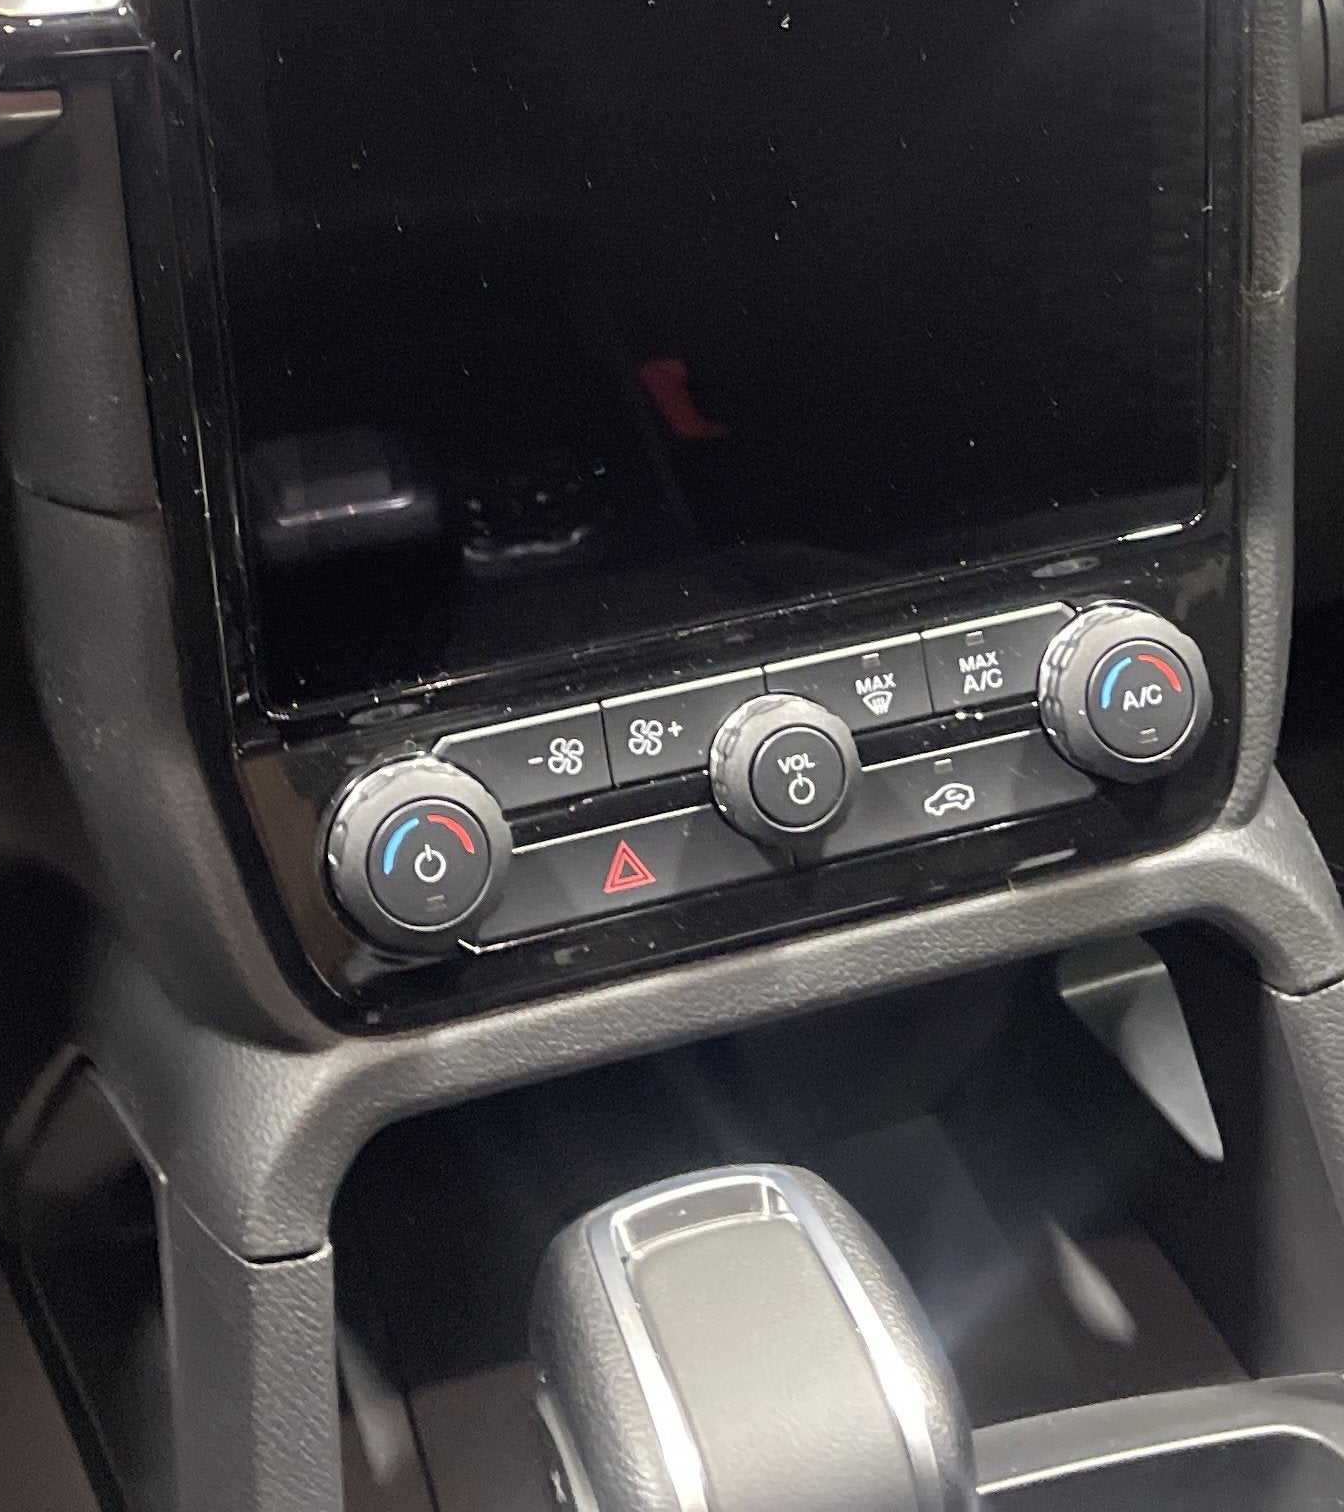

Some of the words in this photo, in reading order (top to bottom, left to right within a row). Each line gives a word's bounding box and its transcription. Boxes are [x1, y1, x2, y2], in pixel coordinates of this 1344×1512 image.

[959, 651, 999, 673] MAX
[854, 672, 897, 693] MAX
[963, 667, 1004, 694] A/C
[1123, 682, 1163, 711] A/C
[777, 752, 816, 774] VOL
